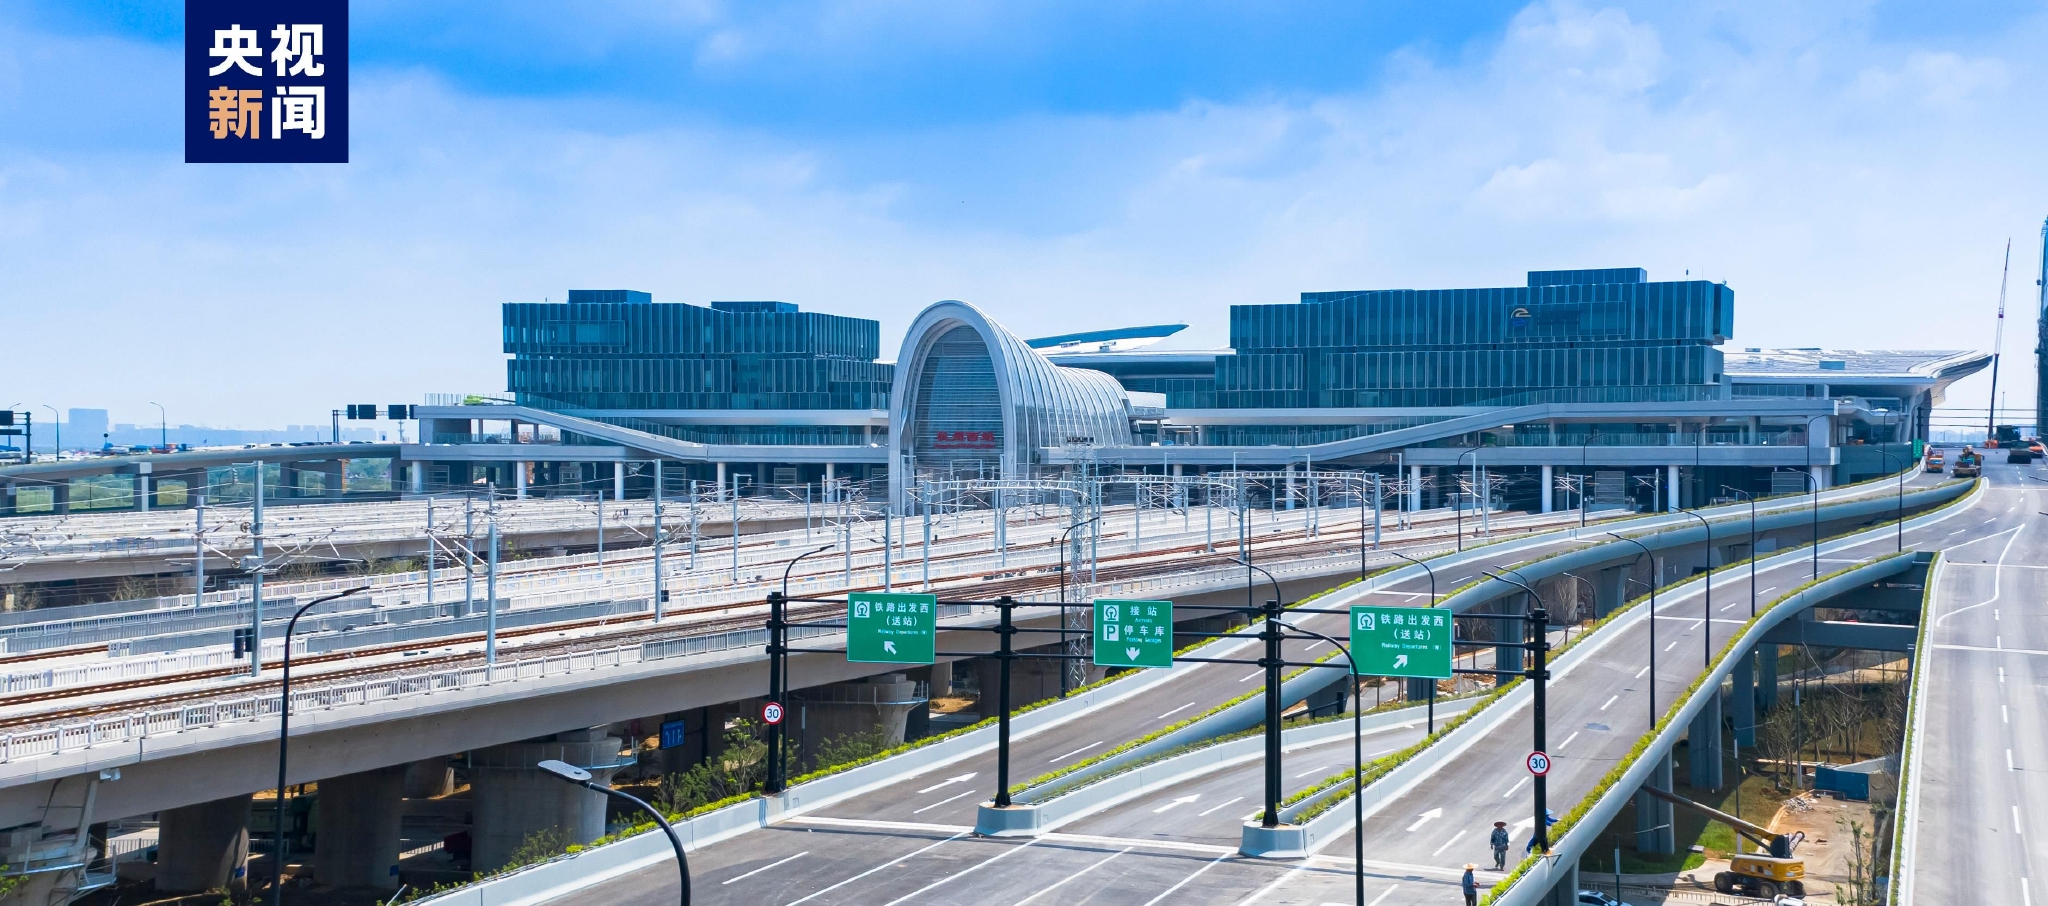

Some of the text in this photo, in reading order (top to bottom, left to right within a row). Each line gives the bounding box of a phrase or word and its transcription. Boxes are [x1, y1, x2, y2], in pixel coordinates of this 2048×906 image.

[875, 602, 929, 613] 铁路出发西
[1130, 605, 1157, 616] 接站
[1380, 613, 1444, 627] 铁路出发西
[1124, 625, 1165, 636] 停车库
[766, 708, 779, 719] 30
[1532, 757, 1546, 769] 30
